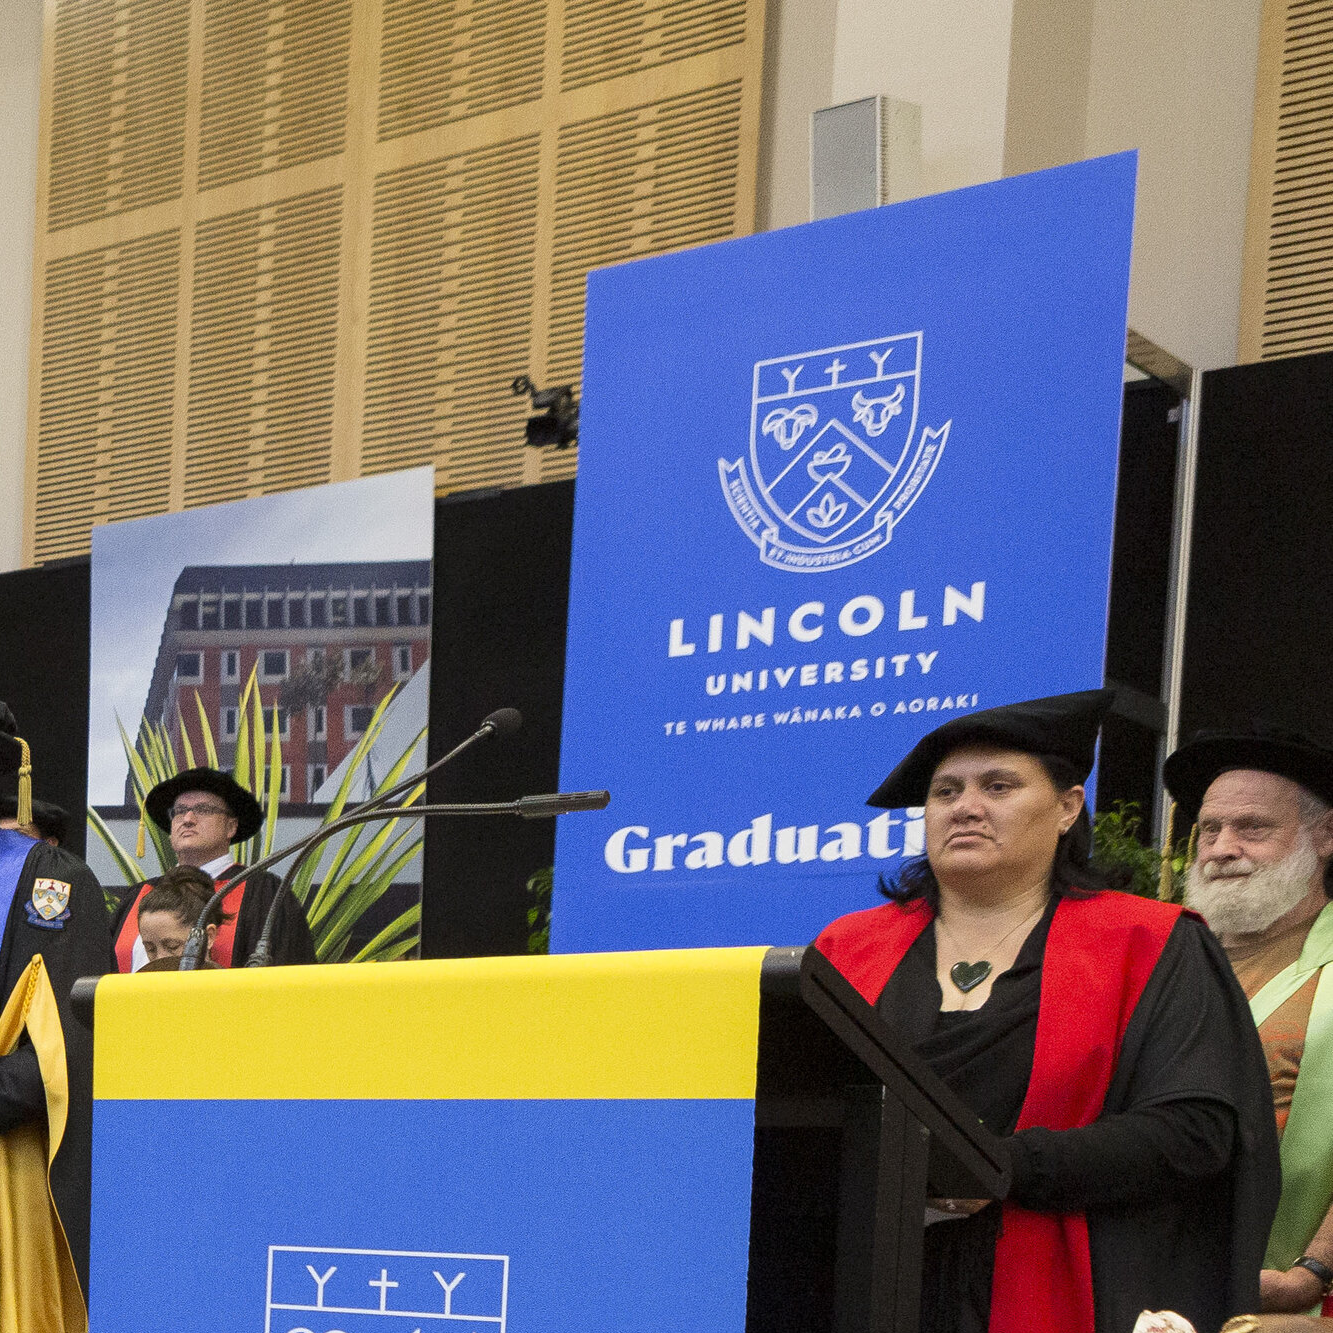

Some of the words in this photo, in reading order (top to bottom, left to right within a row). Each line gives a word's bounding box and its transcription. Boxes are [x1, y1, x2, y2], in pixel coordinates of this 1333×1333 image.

[668, 581, 986, 658] LINCOLN
[705, 651, 939, 696] UNIVERSITY
[664, 721, 687, 736] TE
[695, 713, 766, 733] WHARE
[773, 706, 862, 725] WĀNAKA
[870, 702, 886, 717] O
[893, 693, 979, 715] AORAKI
[604, 806, 926, 874] Graduati
